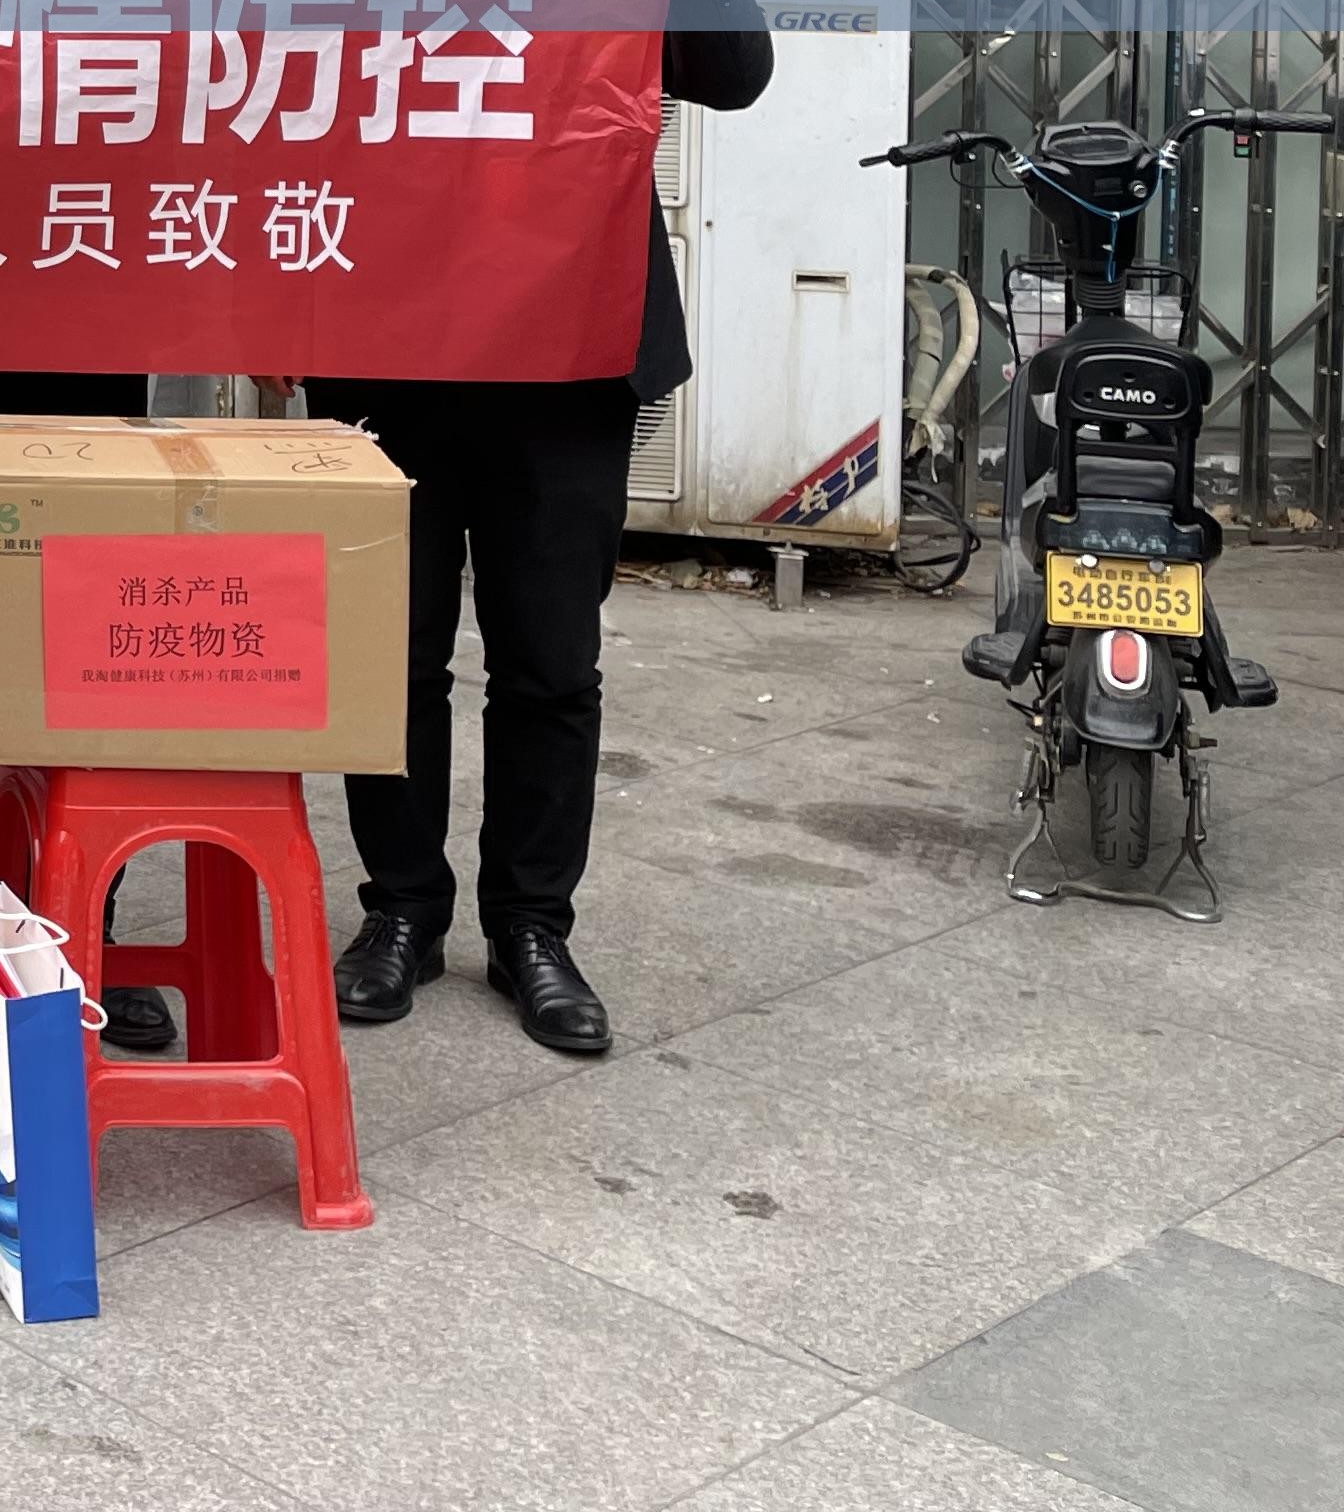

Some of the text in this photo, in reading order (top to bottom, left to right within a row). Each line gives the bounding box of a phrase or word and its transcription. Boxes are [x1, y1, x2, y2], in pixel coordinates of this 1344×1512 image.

[774, 11, 876, 33] GREE
[1100, 387, 1156, 404] CAMO
[117, 576, 250, 608] 消杀产品
[1058, 580, 1192, 616] 3485053
[108, 621, 267, 660] 防疫物资
